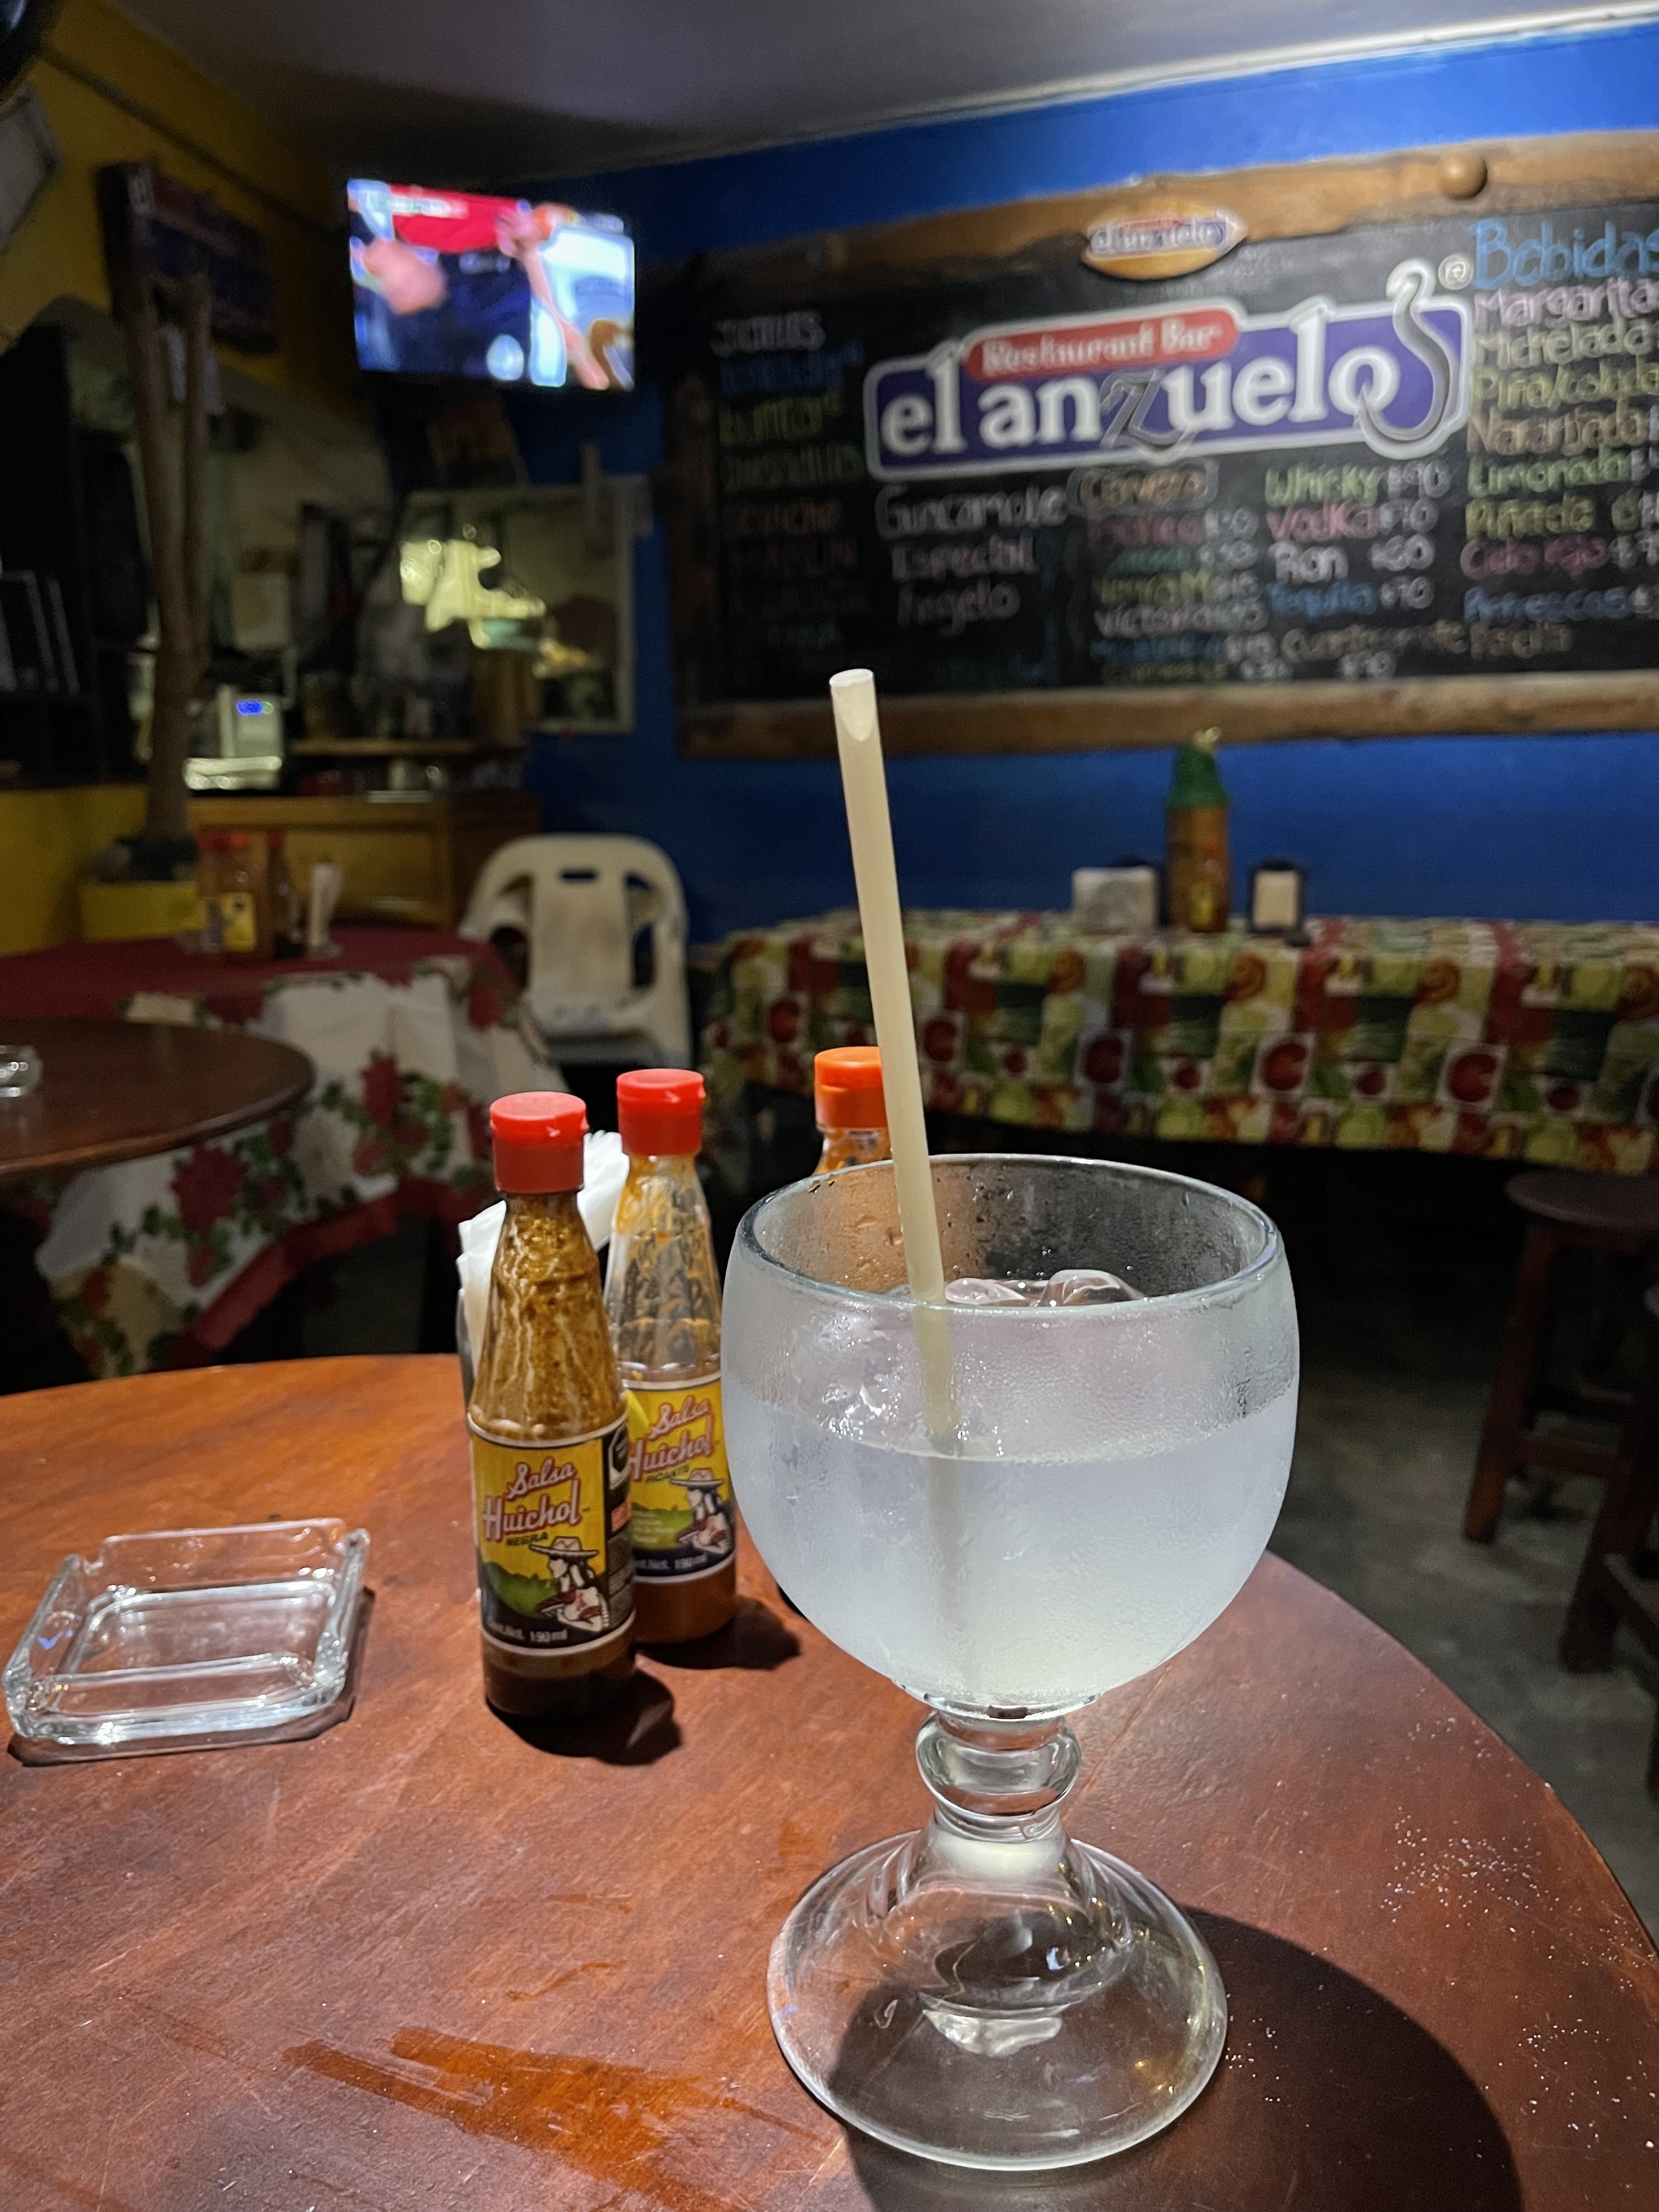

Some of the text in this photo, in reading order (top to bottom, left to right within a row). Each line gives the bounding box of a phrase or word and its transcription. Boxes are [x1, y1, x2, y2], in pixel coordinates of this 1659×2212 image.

[983, 317, 1222, 377] Restaurant Bar
[1474, 314, 1659, 370] Michelada
[880, 354, 967, 455] el
[978, 304, 1426, 460] anzuelo
[1268, 540, 1348, 584] Ron
[646, 1394, 712, 1441] Salsa
[629, 1414, 713, 1482] Huichol
[506, 1456, 577, 1499] Salsa
[483, 1478, 582, 1542] Huichol
